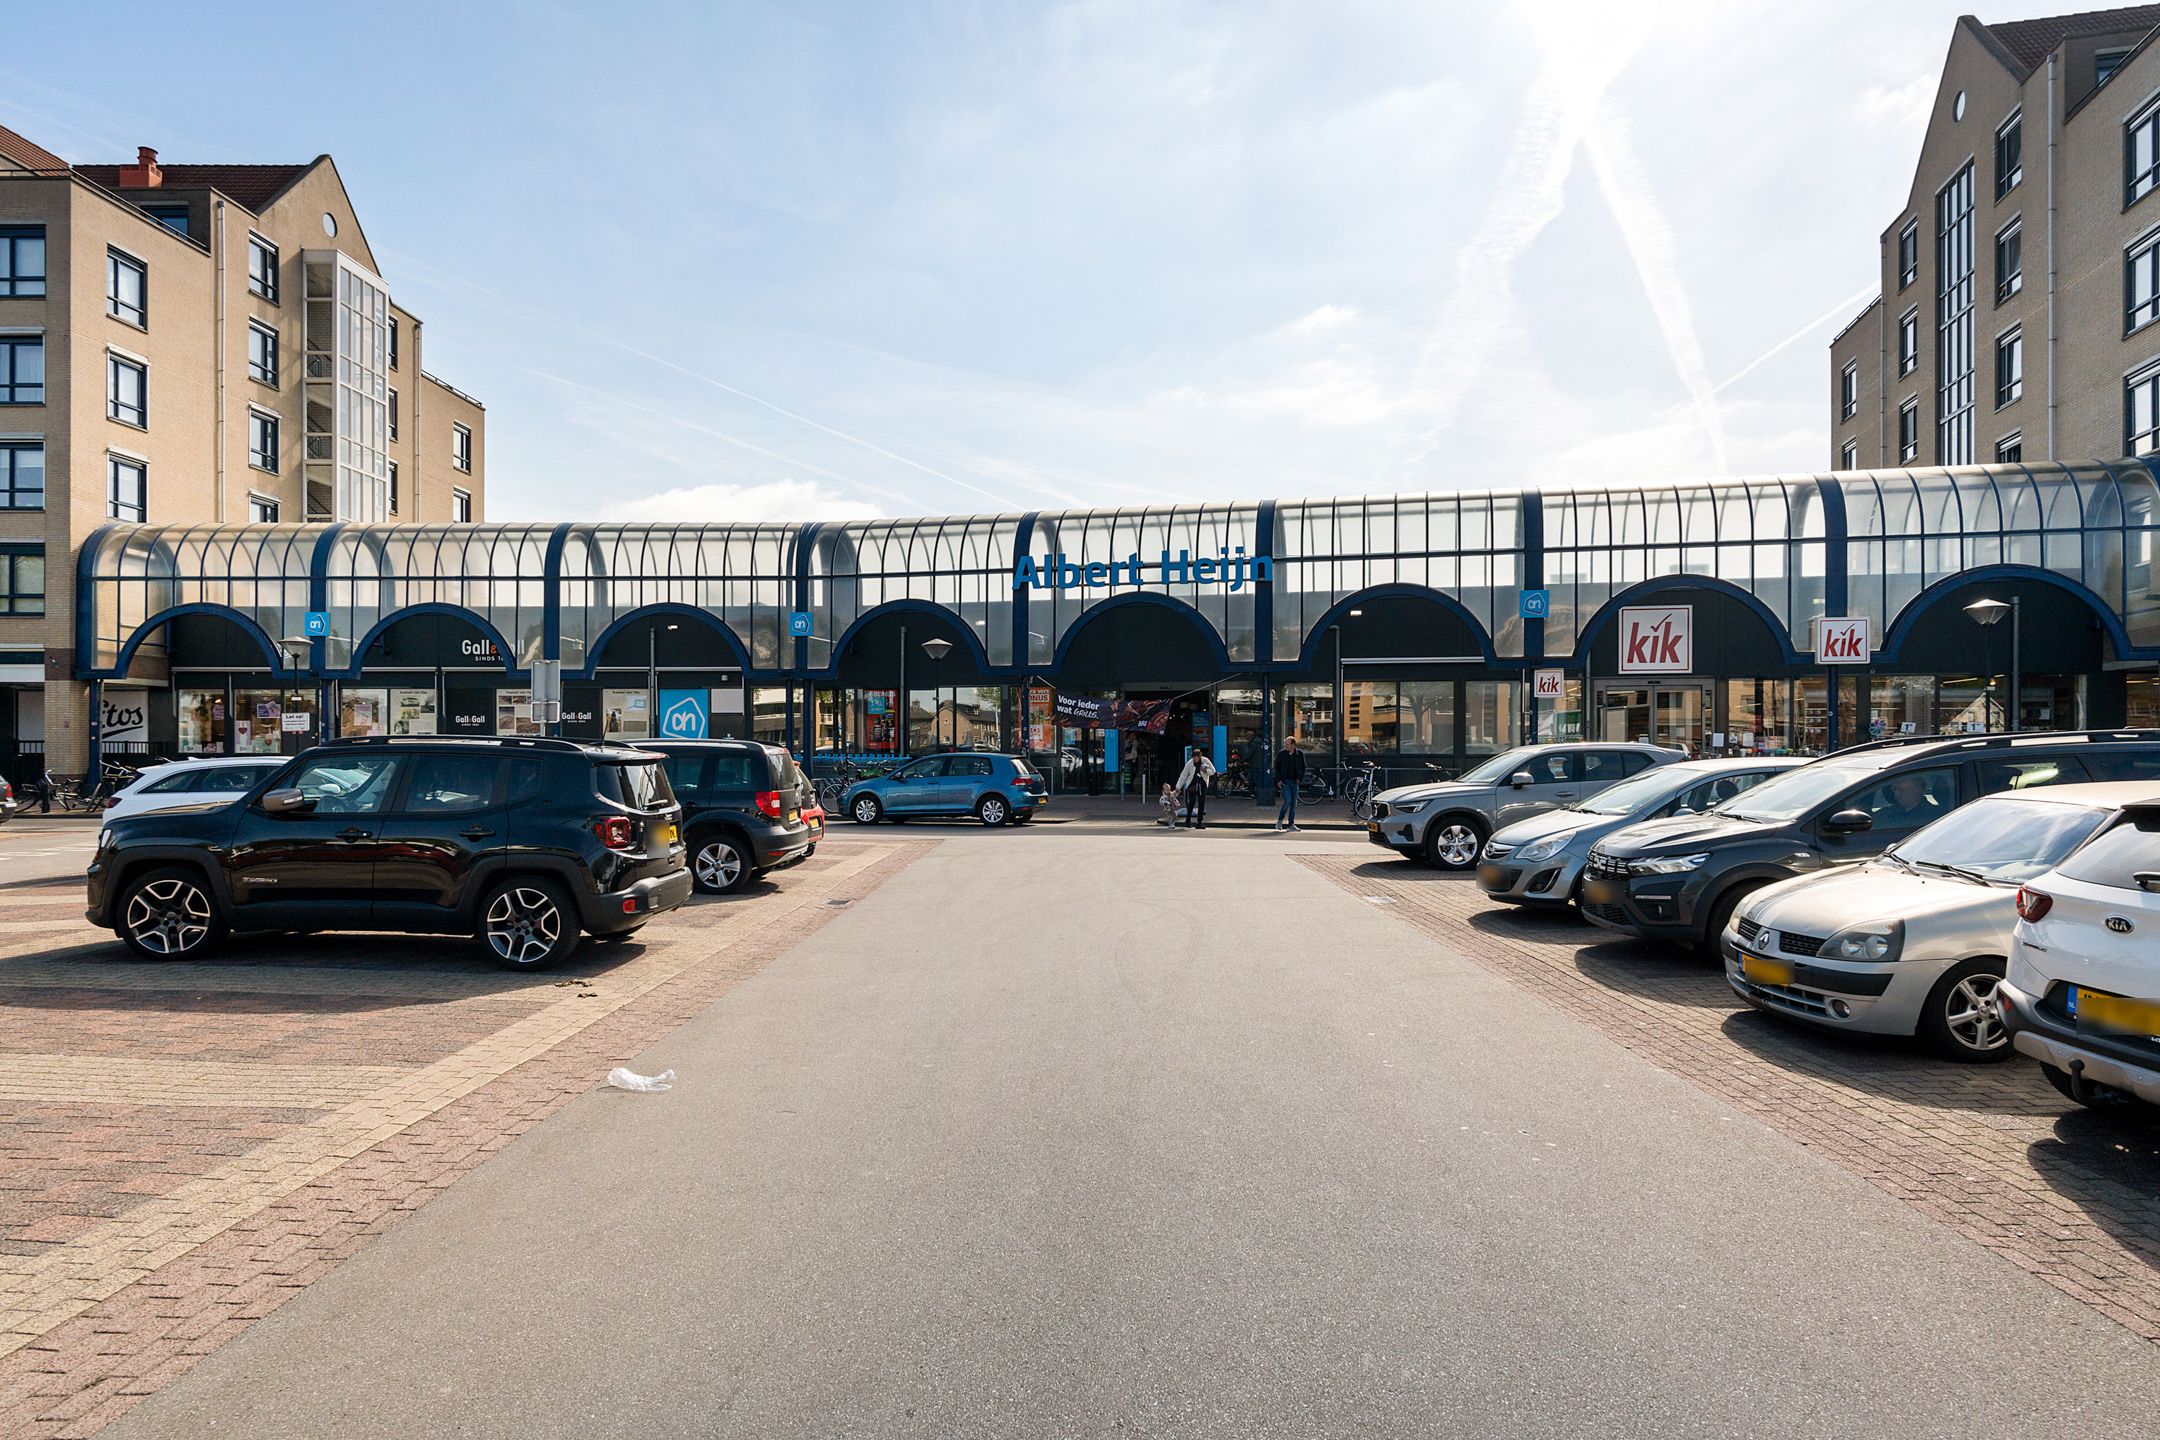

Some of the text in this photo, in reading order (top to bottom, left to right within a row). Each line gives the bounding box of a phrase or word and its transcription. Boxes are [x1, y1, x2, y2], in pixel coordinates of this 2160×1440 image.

[1012, 546, 1273, 592] Albert Heijn
[1056, 704, 1073, 715] wat
[1058, 694, 1100, 710] Voor ieder
[102, 699, 144, 728] tos
